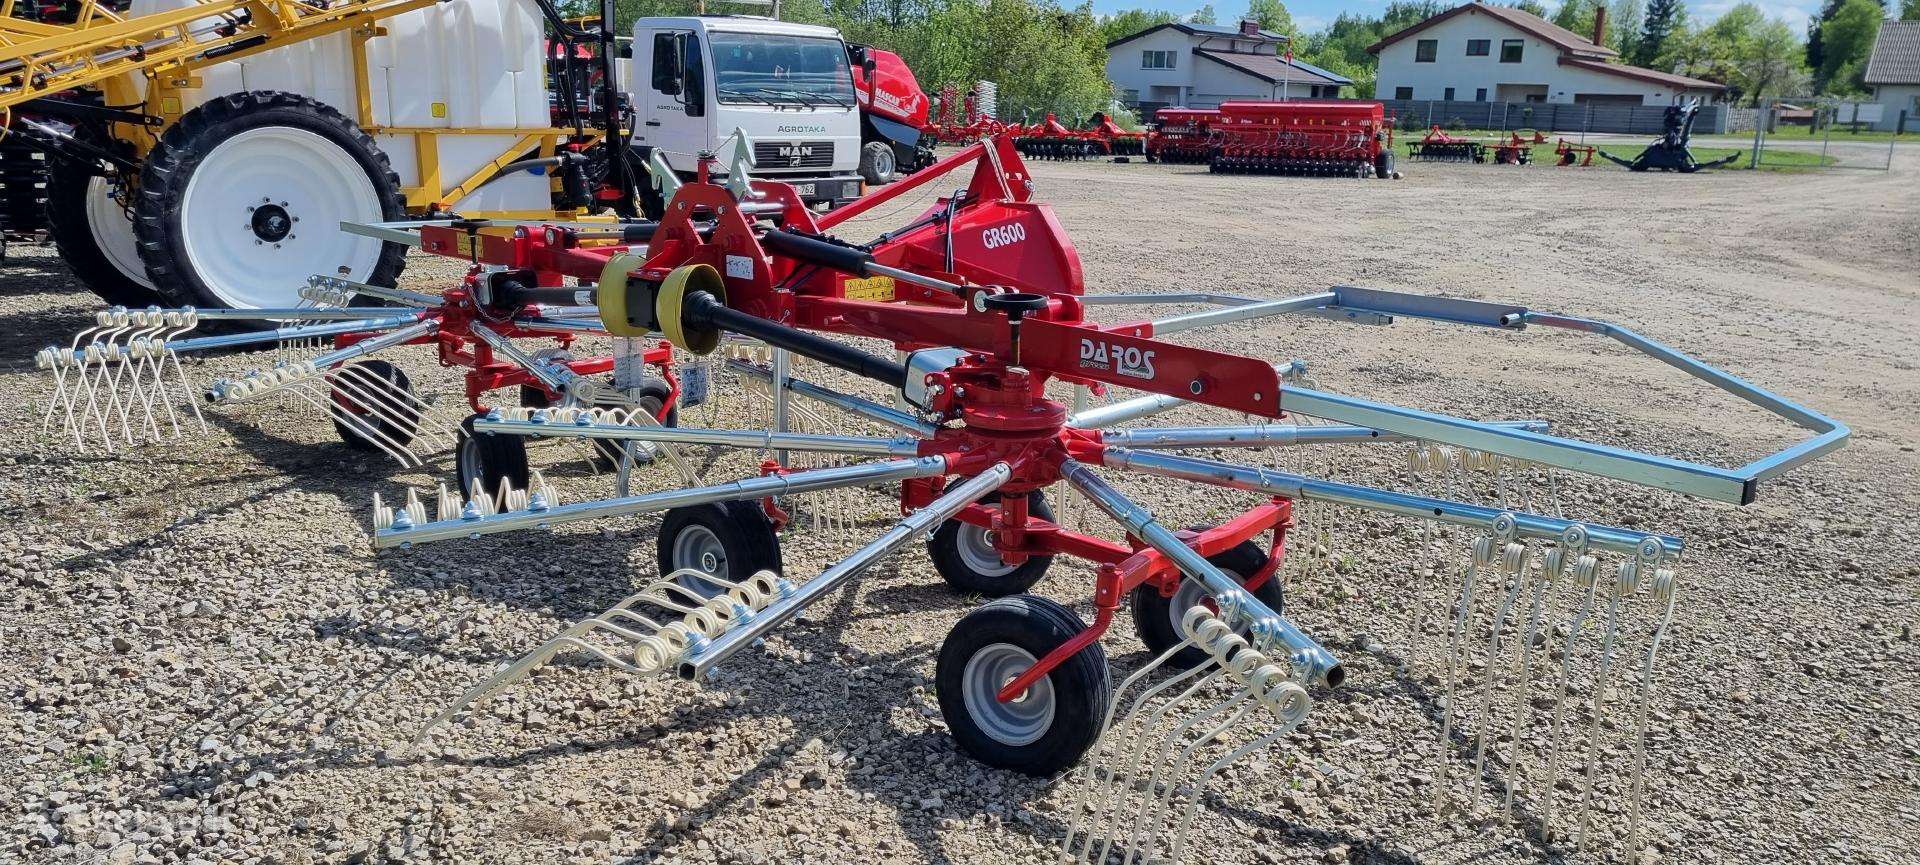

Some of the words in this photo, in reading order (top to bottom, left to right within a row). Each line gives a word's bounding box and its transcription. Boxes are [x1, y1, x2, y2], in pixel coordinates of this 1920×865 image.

[777, 125, 826, 133] AGROTAKA
[779, 146, 812, 156] MAN
[982, 222, 1026, 249] GR600
[1080, 338, 1156, 380] DAROS
